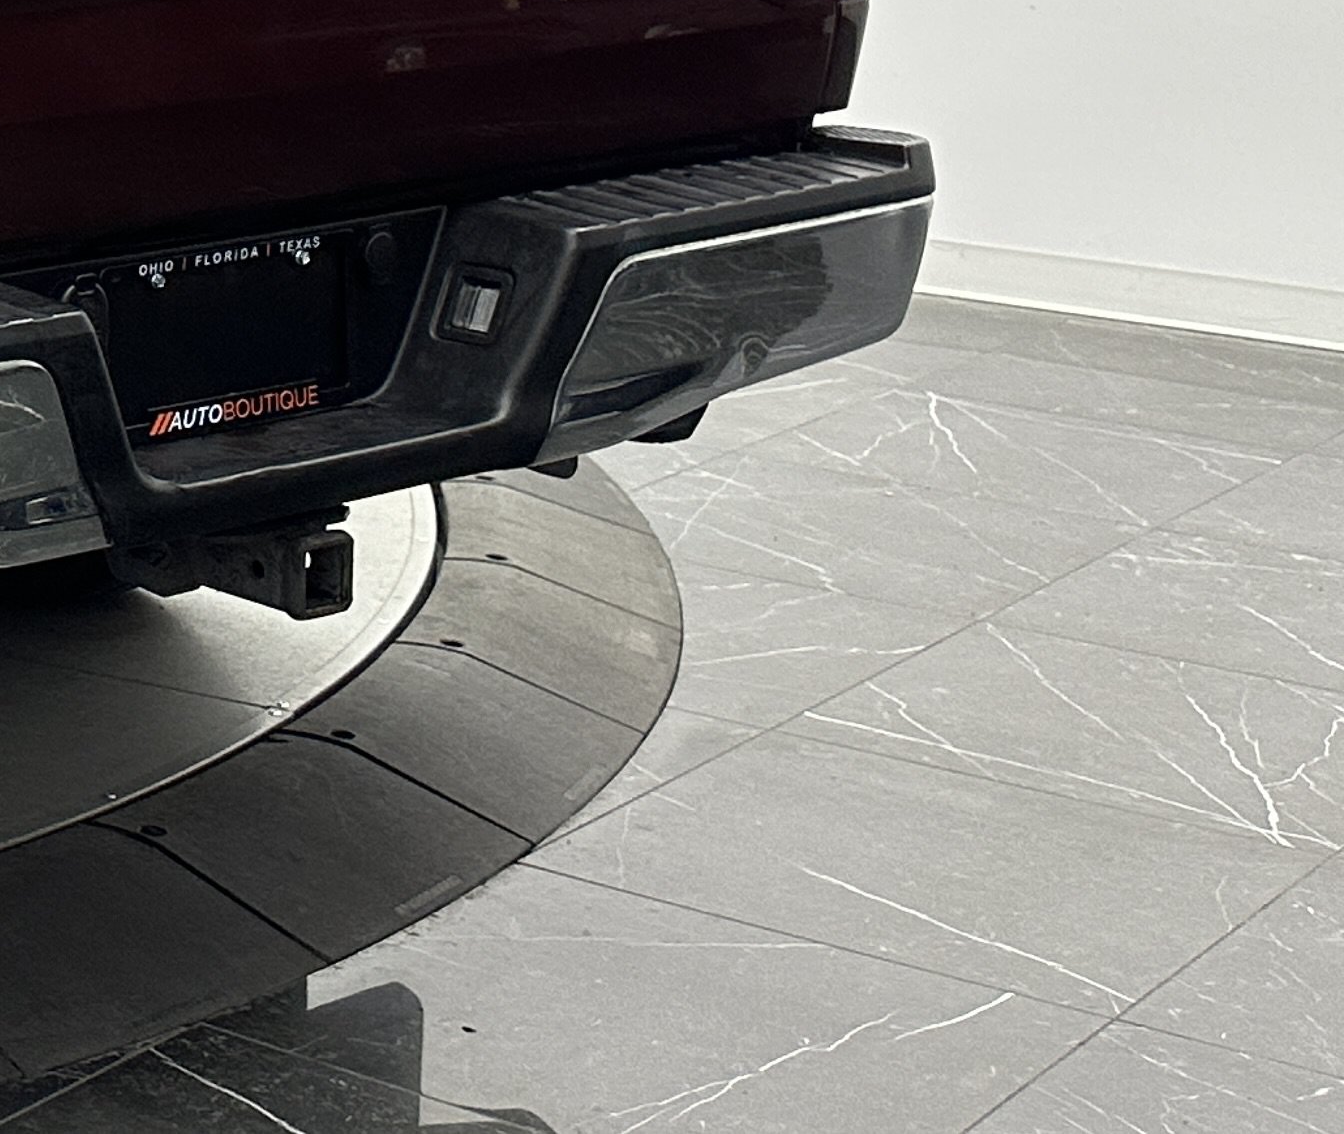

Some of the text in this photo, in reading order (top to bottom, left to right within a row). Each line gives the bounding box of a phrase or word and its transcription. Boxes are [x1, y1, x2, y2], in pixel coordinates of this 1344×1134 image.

[138, 236, 321, 277] OHIO FLORIDA TEXAS
